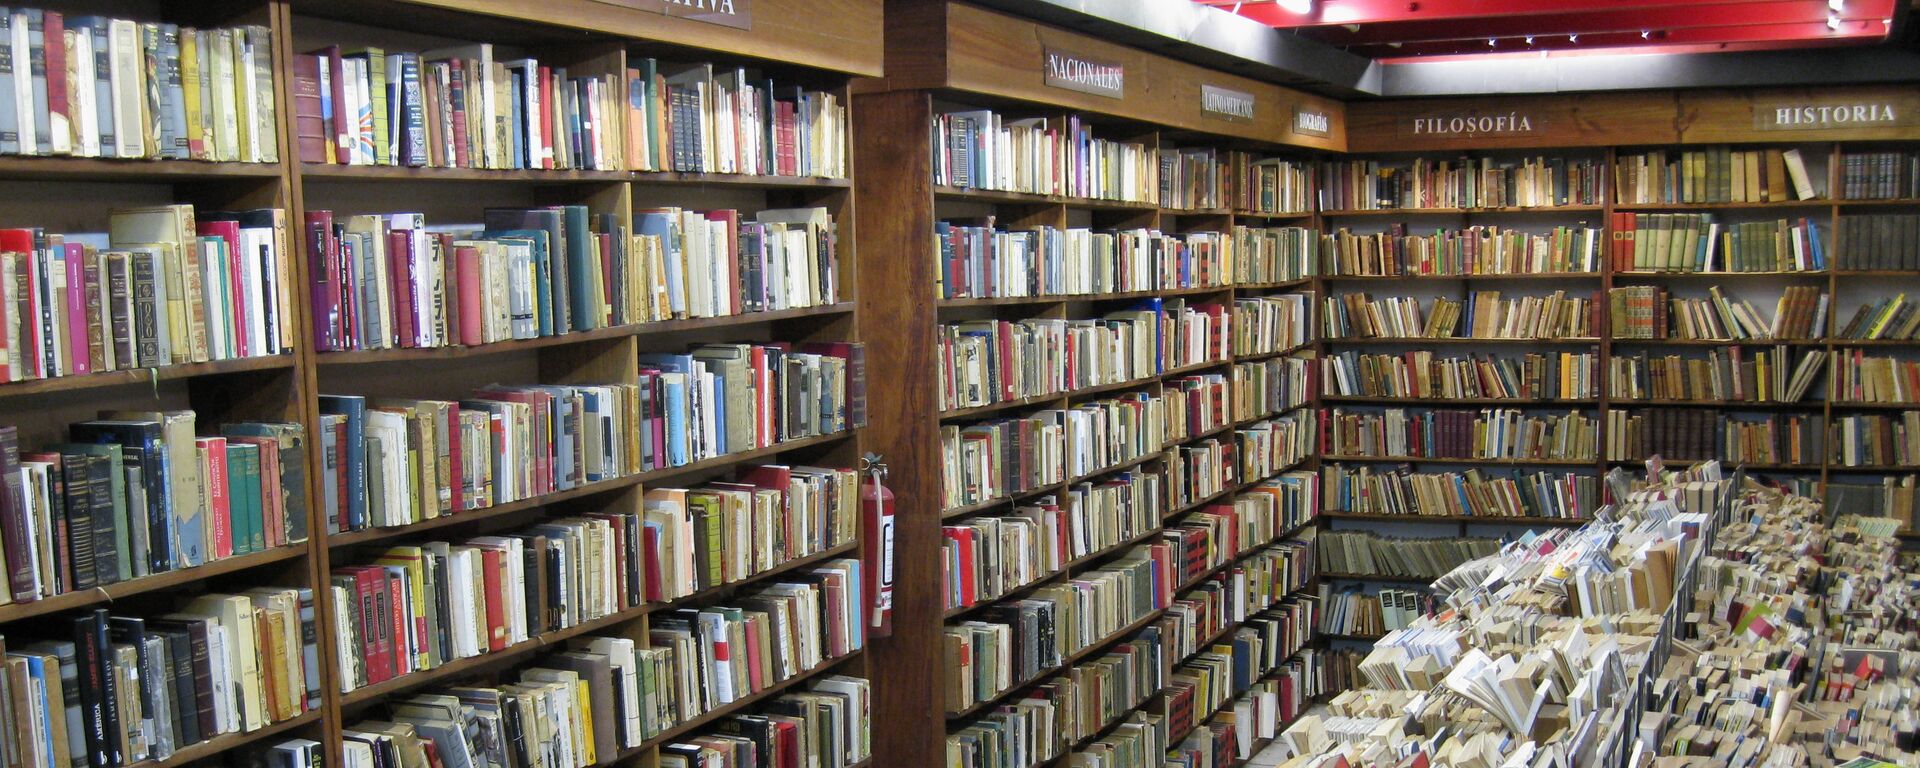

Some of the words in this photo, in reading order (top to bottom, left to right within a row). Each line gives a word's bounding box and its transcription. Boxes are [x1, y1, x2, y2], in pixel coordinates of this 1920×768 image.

[1049, 54, 1120, 90] NACIONALES
[1414, 111, 1532, 134] FILOSOFÍA
[1775, 105, 1895, 124] HISTORIA
[94, 703, 104, 741] AMÉRICA
